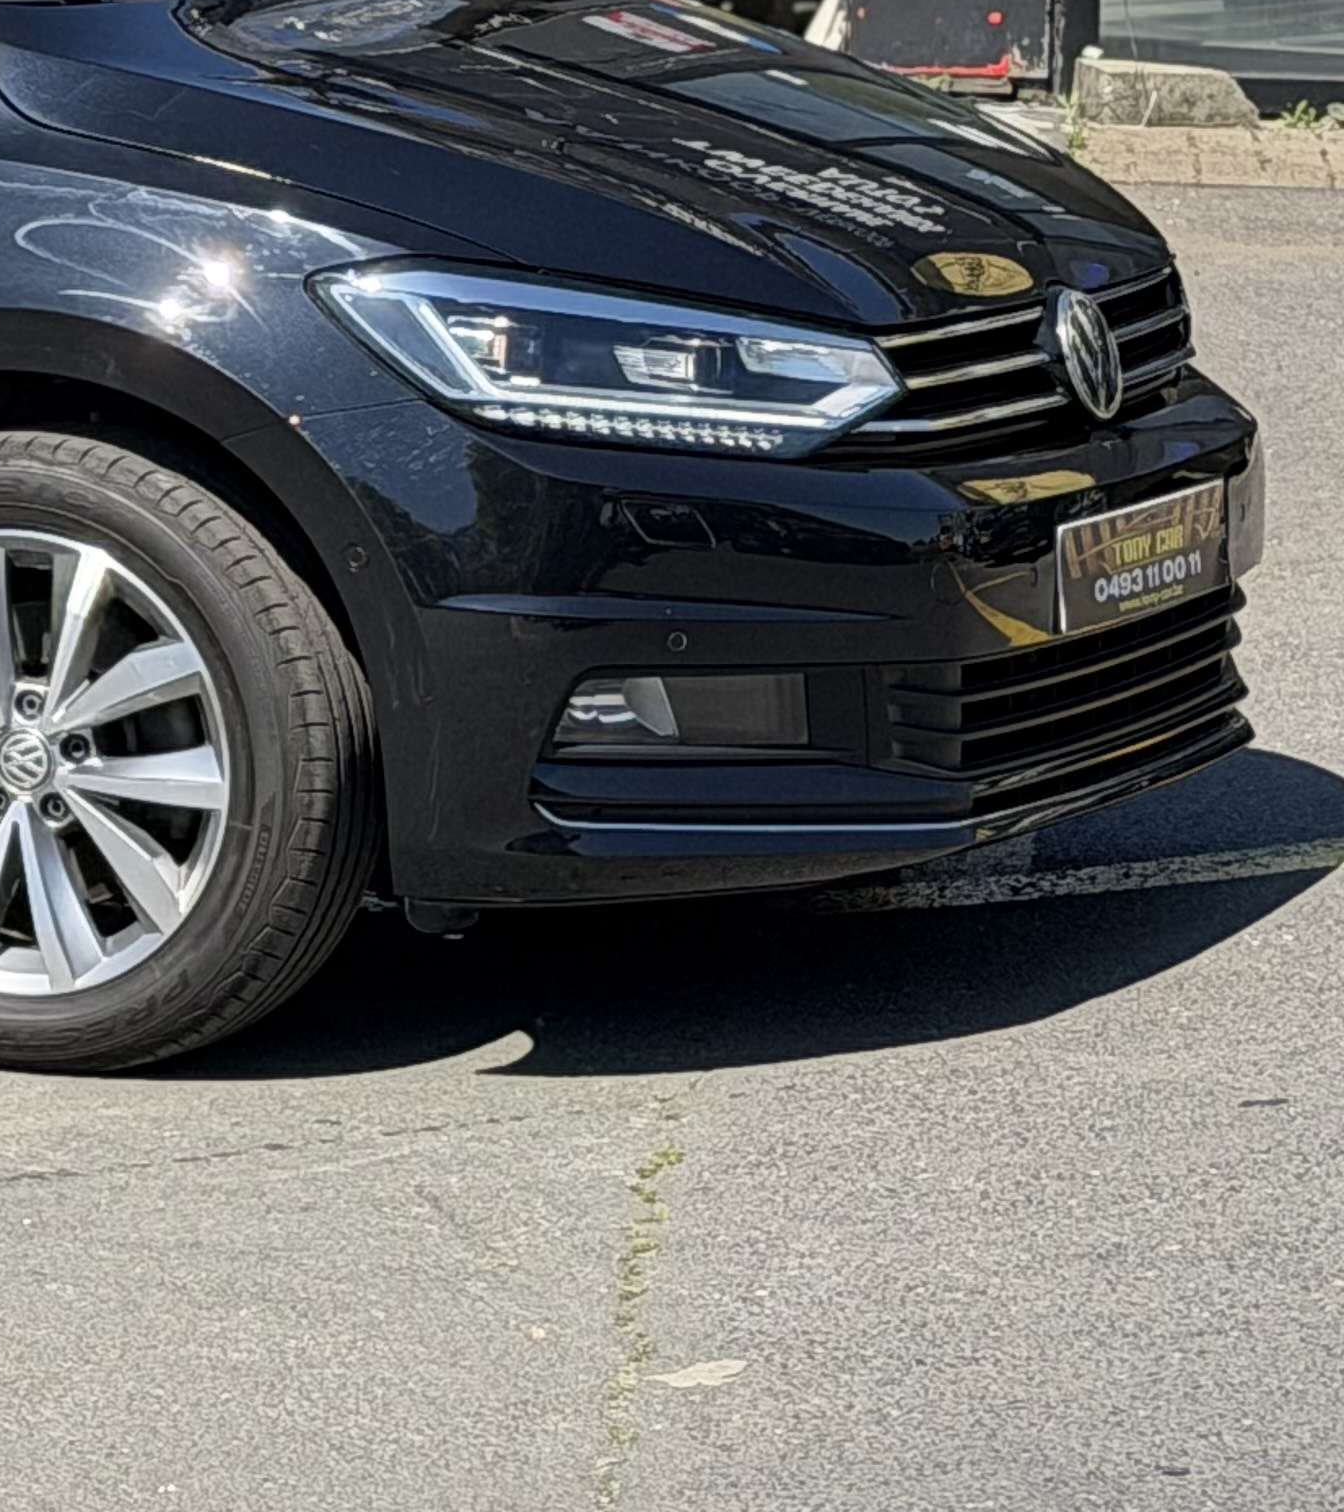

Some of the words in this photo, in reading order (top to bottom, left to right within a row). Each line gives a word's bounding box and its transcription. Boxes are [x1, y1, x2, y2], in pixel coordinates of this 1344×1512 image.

[1112, 534, 1152, 566] TONY
[1155, 524, 1184, 555] CAR
[1093, 567, 1144, 603] 0493
[1145, 561, 1161, 589] 11
[1161, 554, 1187, 585] 00
[1187, 549, 1202, 575] 11
